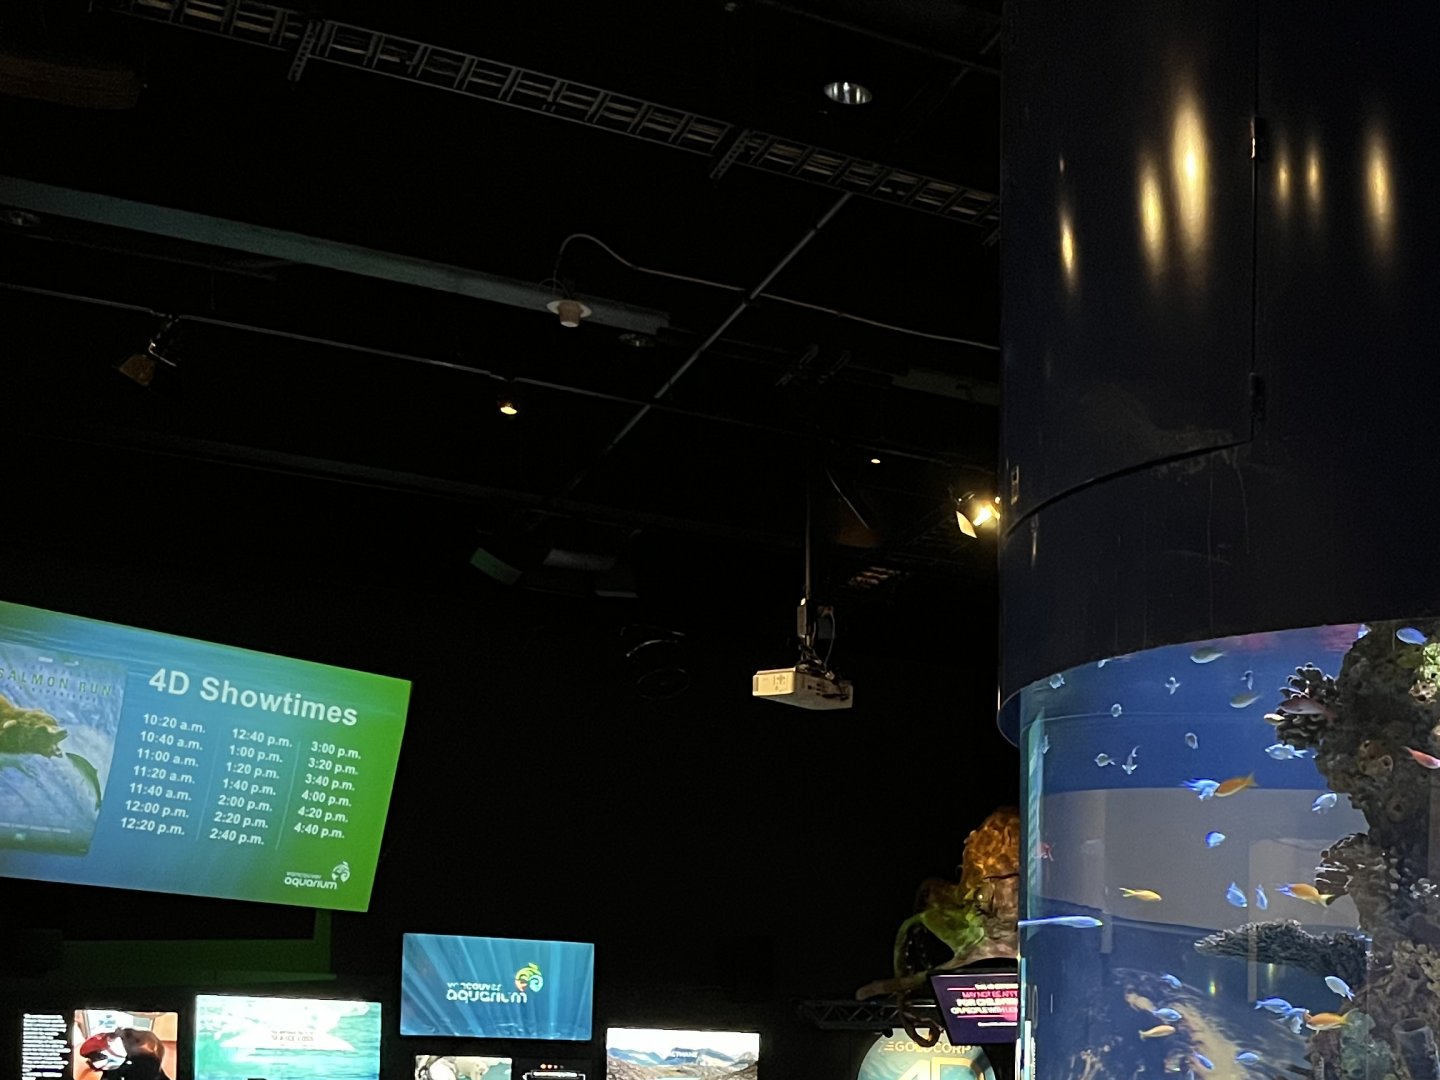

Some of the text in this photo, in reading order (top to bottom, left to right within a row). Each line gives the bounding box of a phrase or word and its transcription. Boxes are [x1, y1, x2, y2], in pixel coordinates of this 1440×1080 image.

[0, 668, 69, 689] SALMON
[79, 681, 112, 697] RUN
[149, 668, 358, 727] 4D Showtimes
[143, 713, 206, 733] 10:20 a.m.
[140, 731, 203, 750] 10:40 a.m.
[232, 728, 293, 747] 12:40 p.m.
[137, 748, 199, 767] 11:00 a.m.
[229, 745, 283, 763] 1:00 p.m.
[311, 741, 362, 759] 3:00 p.m.
[133, 765, 196, 784] 11:20 a.m.
[226, 762, 280, 779] 1:20 p.m.
[308, 758, 359, 775] 3:20 p.m.
[223, 778, 276, 796] 1:40 p.m.
[305, 773, 356, 791] 3:40 p.m.
[129, 782, 192, 801] 11:40 a.m.
[301, 790, 352, 807] 4:00 p.m.
[125, 800, 189, 818] 12:00 p.m.
[218, 795, 273, 812] 2:00 p.m.
[213, 811, 269, 829] 2:20 p.m.
[298, 806, 349, 823] 4:20 p.m.
[121, 817, 185, 835] 12:20 p.m.
[294, 822, 345, 839] 4:40 p.m.
[209, 828, 265, 845] 2:40 p.m.
[284, 876, 338, 890] aquarium
[446, 989, 527, 1004] aquarium
